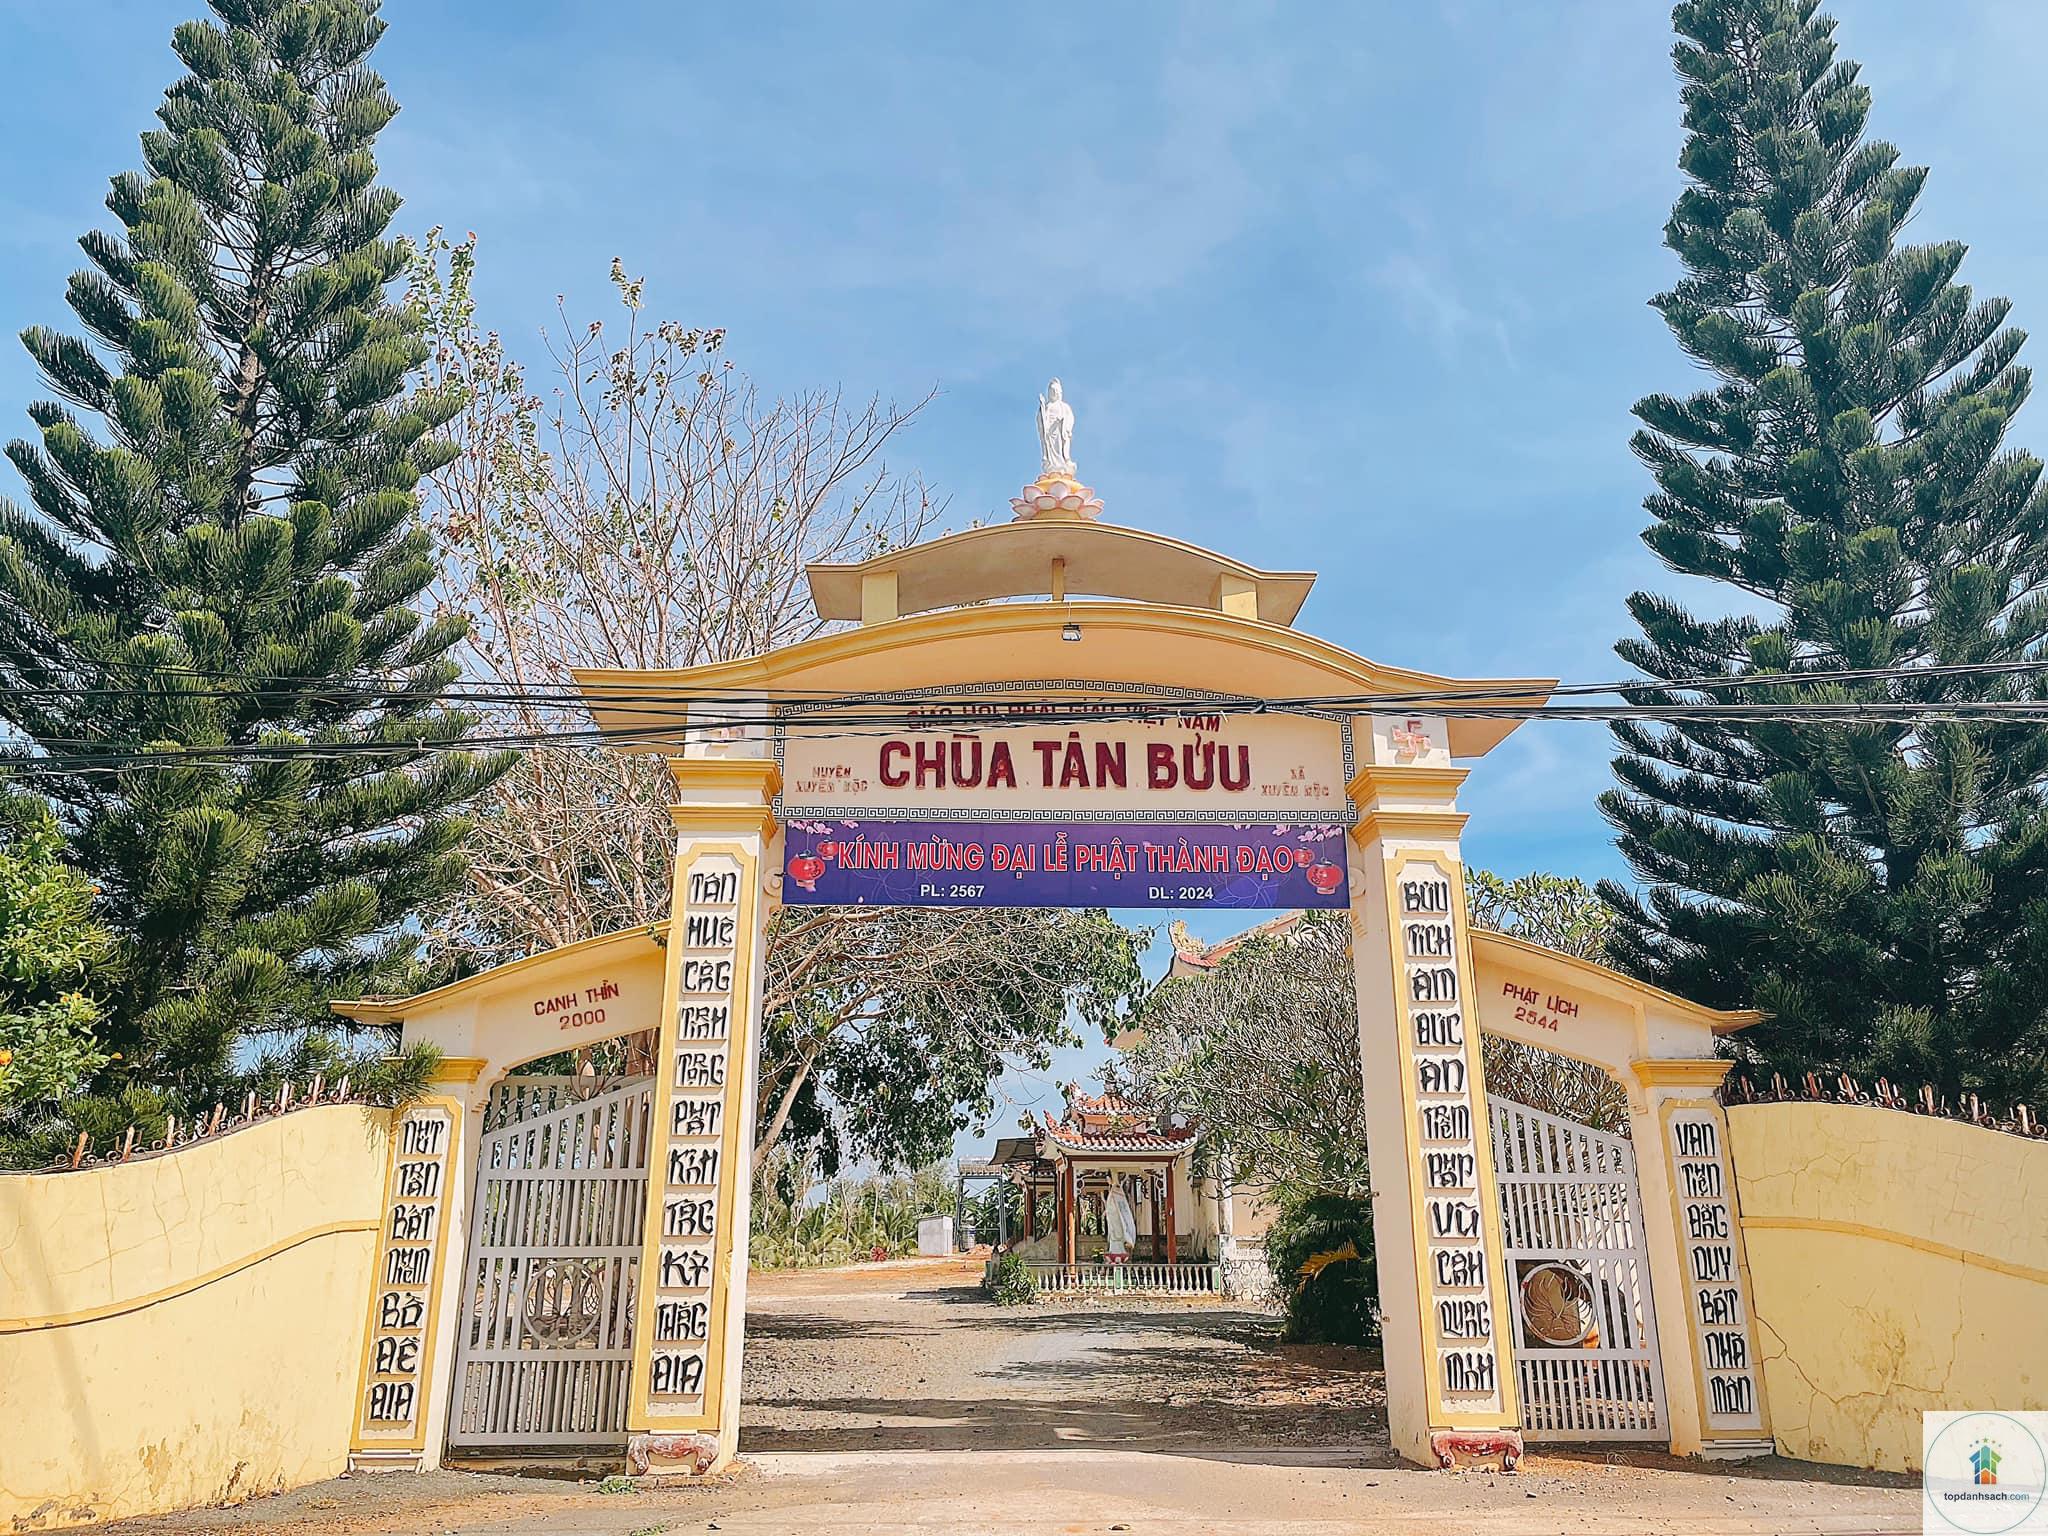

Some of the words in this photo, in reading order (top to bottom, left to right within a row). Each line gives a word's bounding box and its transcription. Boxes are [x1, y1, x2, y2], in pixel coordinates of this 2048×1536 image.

[879, 733, 1017, 790] CHÙA
[1033, 731, 1127, 789] TÂN
[1147, 732, 1251, 791] BỬU
[838, 834, 899, 870] KÍNH
[906, 834, 985, 870] MỪNG
[992, 844, 1036, 879] ĐẠI
[1044, 832, 1068, 872] LỄ
[1075, 836, 1139, 880] PHẬT
[1146, 836, 1230, 873] THÀNH
[1236, 845, 1294, 880] ĐẠO
[692, 872, 737, 903] TÂN
[920, 884, 945, 898] PL:
[950, 884, 985, 898] 2567
[1149, 887, 1174, 900] DL:
[1179, 887, 1215, 900] 2024
[688, 915, 735, 947] HUỆ
[1408, 924, 1452, 956] TÍCH
[1411, 968, 1456, 1001] ÂM
[533, 992, 578, 1016] CANH
[559, 1008, 606, 1031] 2000
[1514, 1006, 1559, 1032] 2544
[1546, 995, 1579, 1018] LỊCH
[1416, 1012, 1463, 1045] ĐỨC
[1420, 1058, 1465, 1093] ÂN
[1675, 1122, 1716, 1156] VẠN
[1432, 1202, 1479, 1237] VŨ
[1692, 1246, 1731, 1281] QUY
[1698, 1287, 1738, 1324] BÁT
[1704, 1331, 1746, 1369] NHÃ
[653, 1354, 703, 1393] ĐỊA
[370, 1382, 415, 1421] ĐỊA
[1710, 1375, 1751, 1413] MÔN
